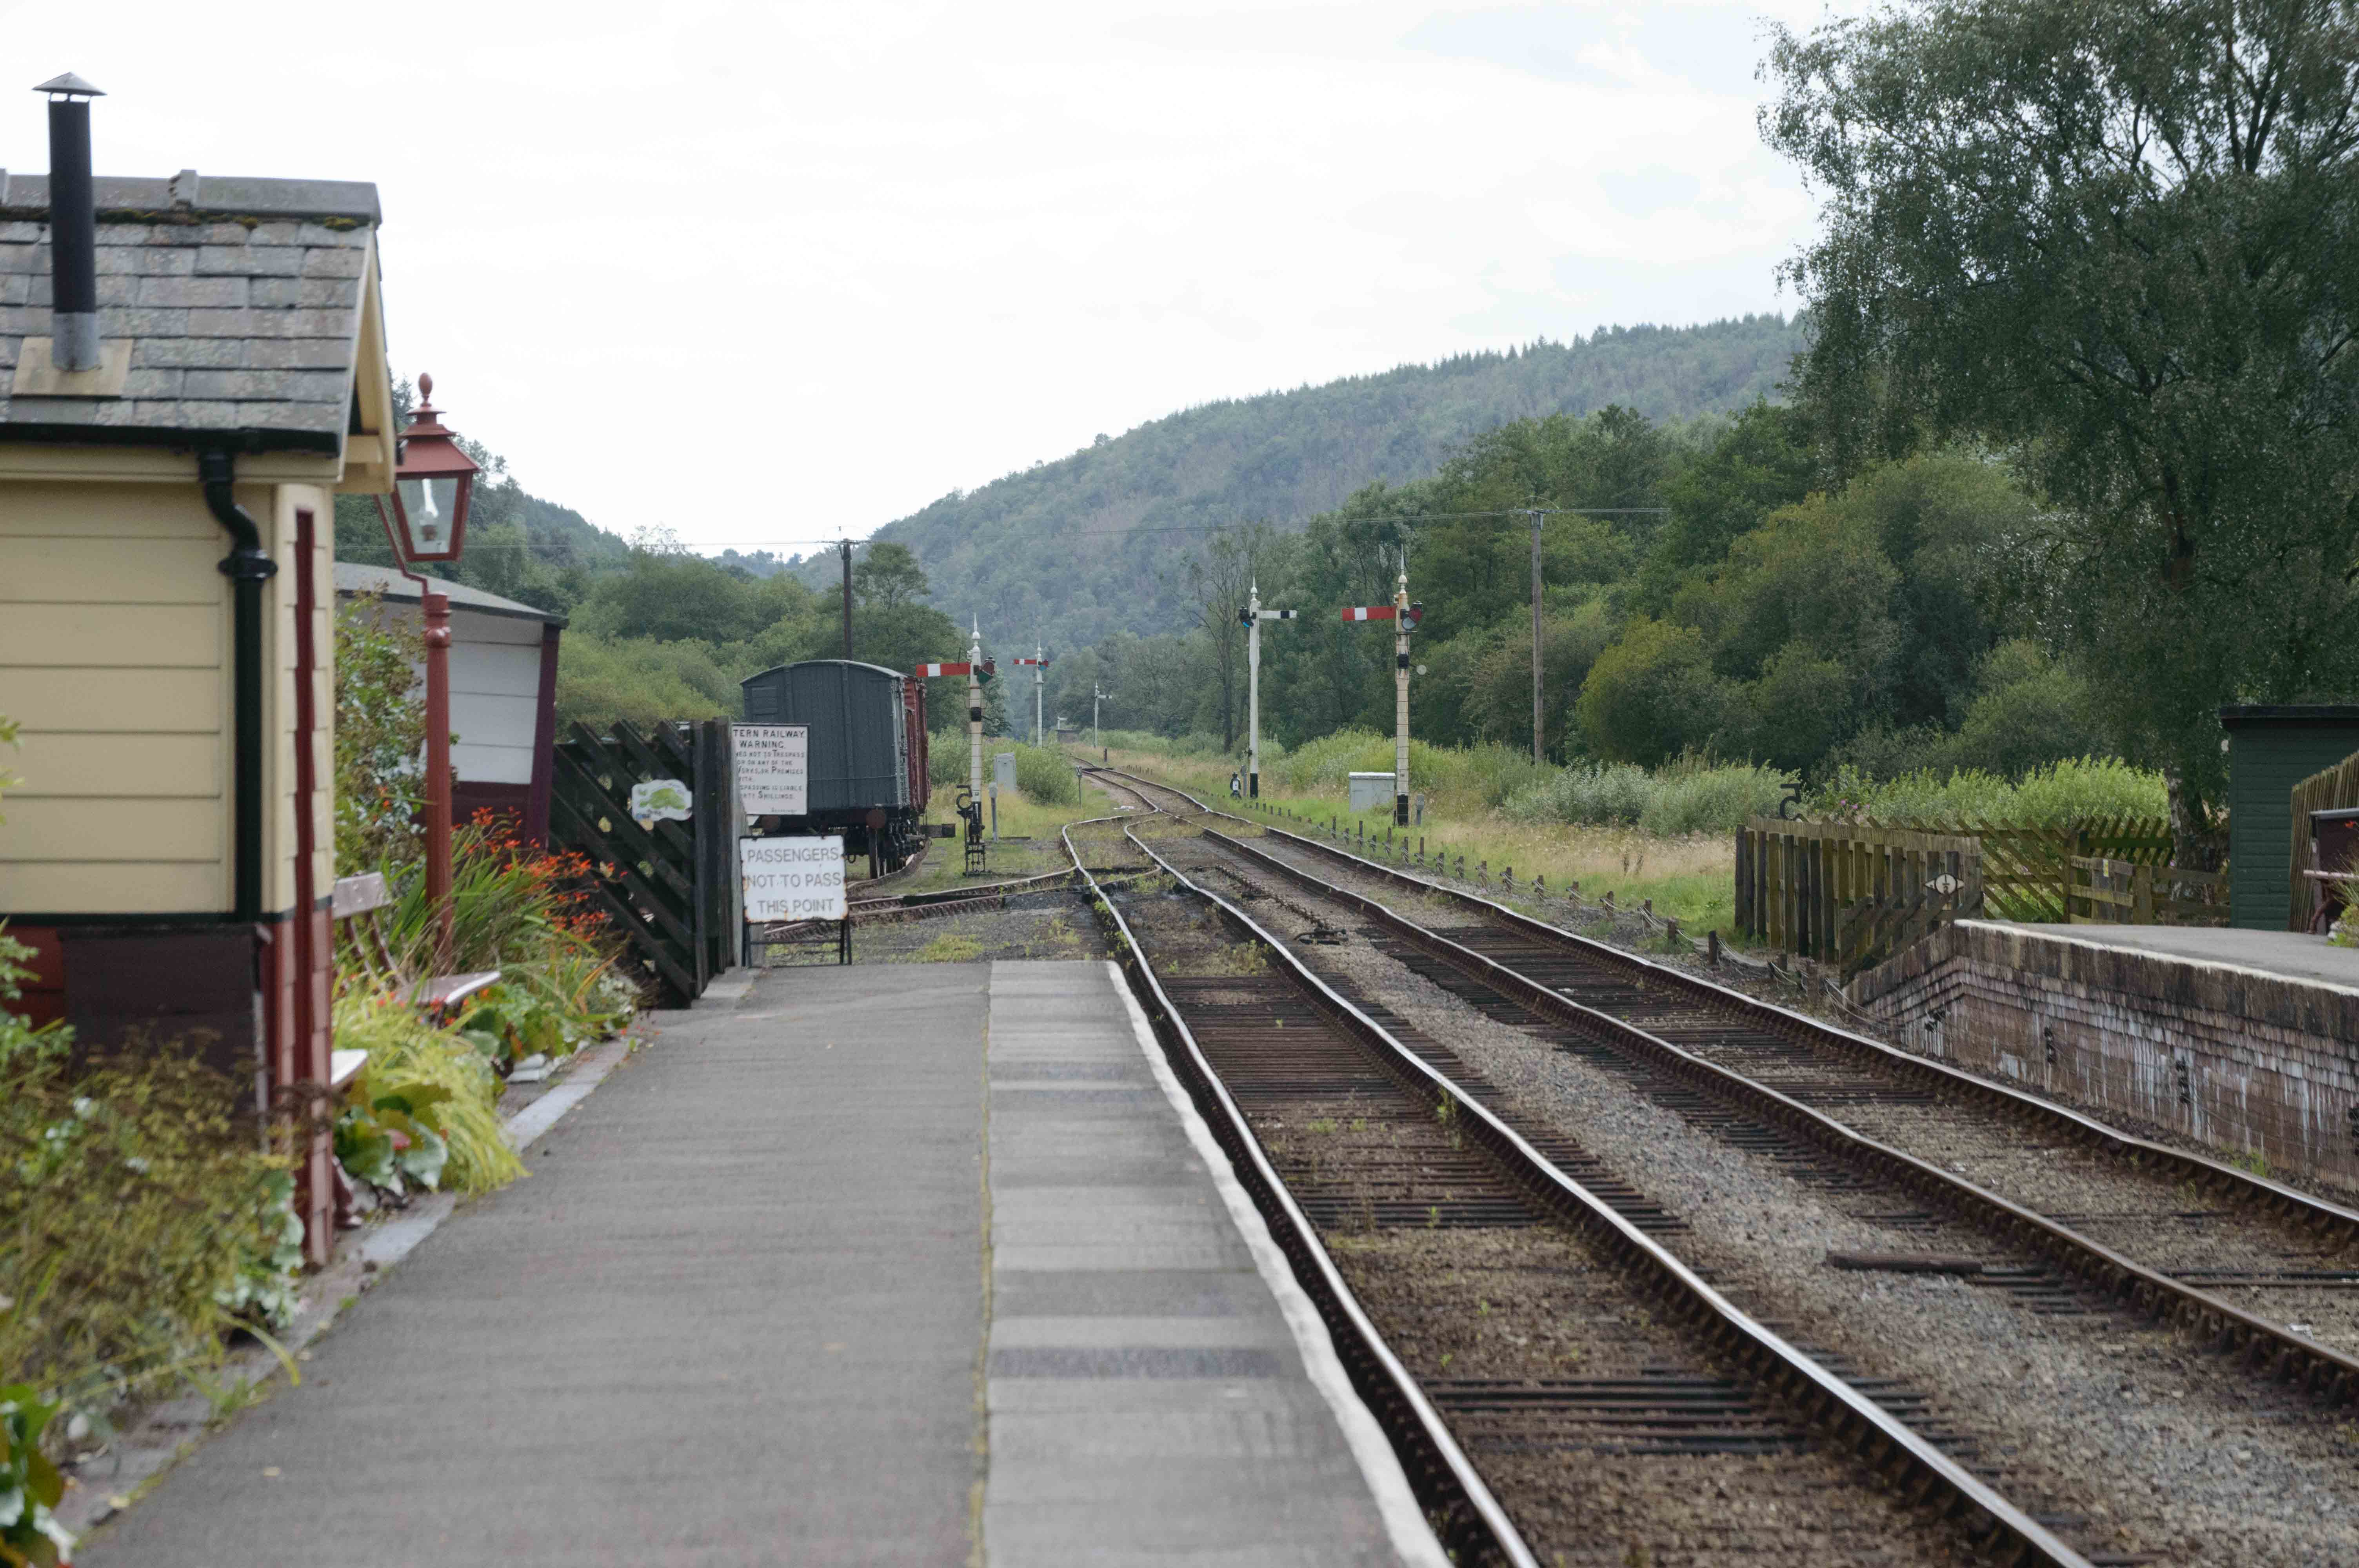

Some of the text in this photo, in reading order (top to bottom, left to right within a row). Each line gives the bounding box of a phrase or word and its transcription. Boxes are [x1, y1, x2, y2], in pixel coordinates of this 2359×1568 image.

[733, 729, 805, 738] TERN RAILWAY
[747, 847, 839, 863] PASSENGERS
[747, 872, 841, 888] NOT TO PASS
[757, 898, 834, 914] THIS POINT
